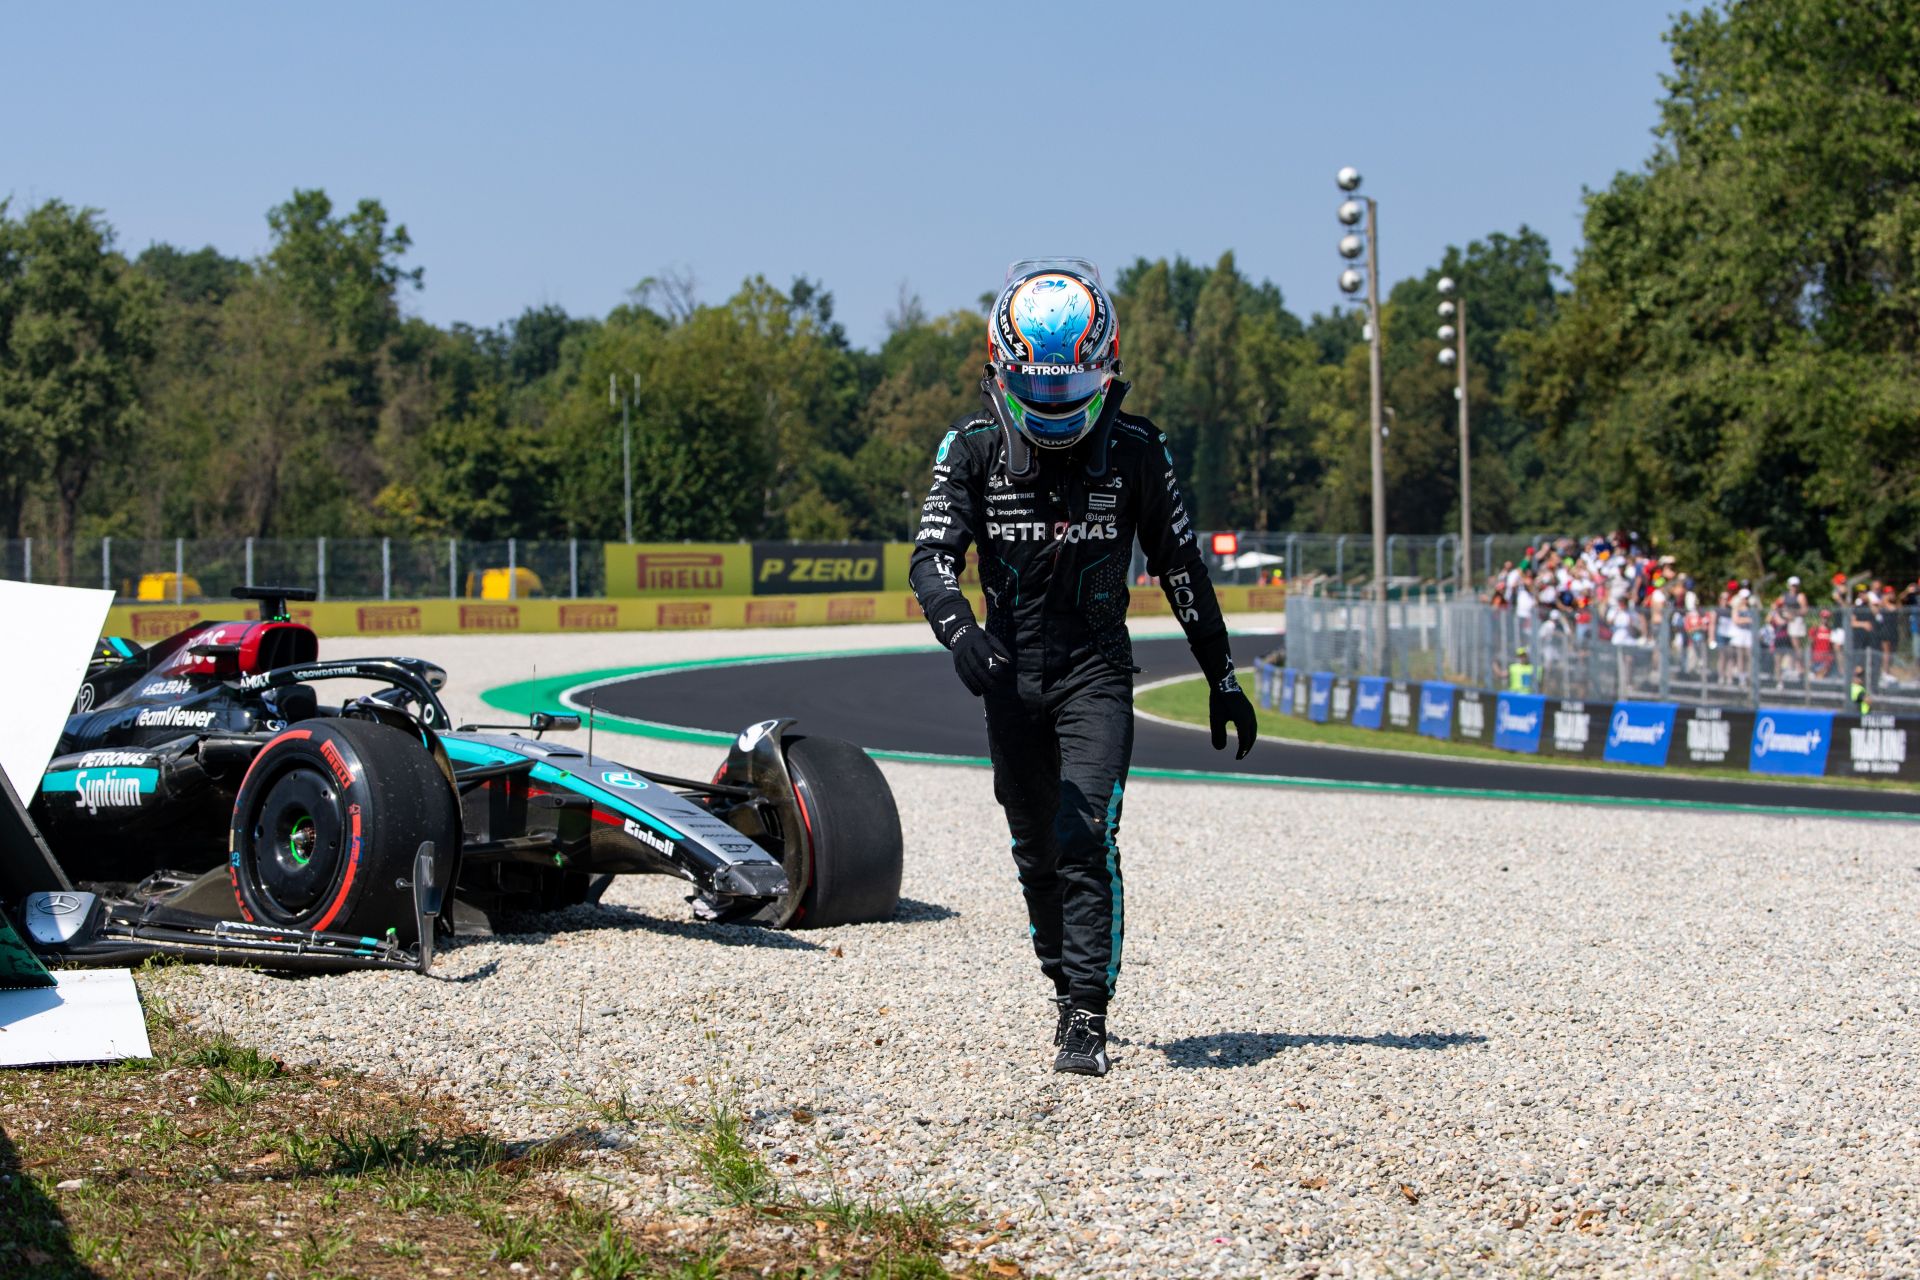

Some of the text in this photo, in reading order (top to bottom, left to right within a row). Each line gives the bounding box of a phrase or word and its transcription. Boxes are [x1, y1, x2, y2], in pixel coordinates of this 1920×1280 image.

[1021, 364, 1084, 375] PETRONAS
[988, 492, 1035, 501] CROWDSTRIKE
[637, 553, 723, 590] PIRELLI
[759, 558, 878, 582] P ZERO
[298, 666, 358, 678] CROWDSTRIKE
[135, 706, 216, 727] TeamViewer
[78, 752, 152, 768] PETRONAS
[320, 739, 356, 790] PIRELLI
[75, 769, 142, 816] Syntium
[624, 818, 674, 857] Einhell
